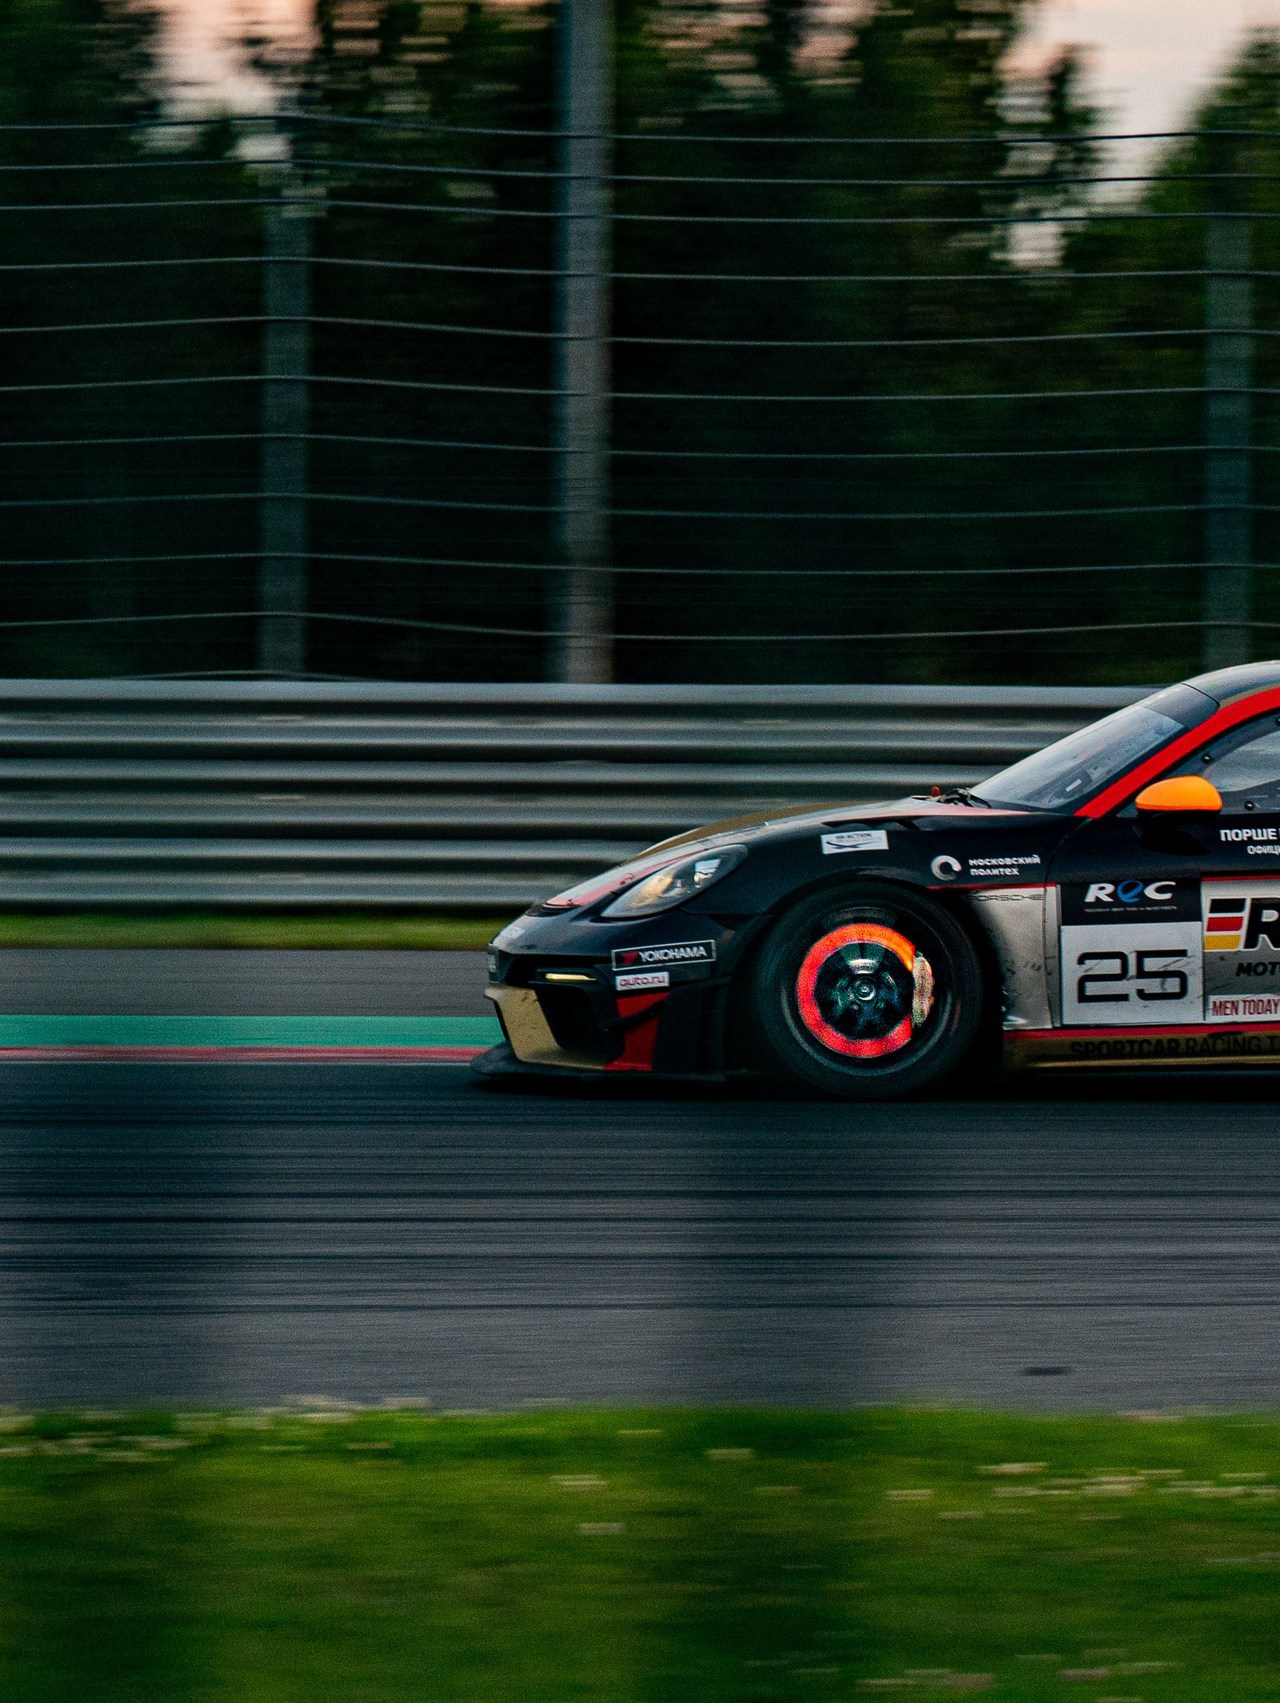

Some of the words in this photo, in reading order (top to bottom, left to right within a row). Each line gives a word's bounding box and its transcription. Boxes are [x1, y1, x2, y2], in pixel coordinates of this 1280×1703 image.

[1220, 828, 1277, 841] ПОРШЕ
[639, 946, 708, 962] YOKOHAMA
[620, 976, 666, 987] auto.ru
[1077, 949, 1188, 1003] 25
[1211, 1001, 1240, 1017] MEN
[1242, 999, 1280, 1016] TODAY
[1070, 1038, 1180, 1058] SPORTCAR
[1184, 1036, 1261, 1055] RACING
